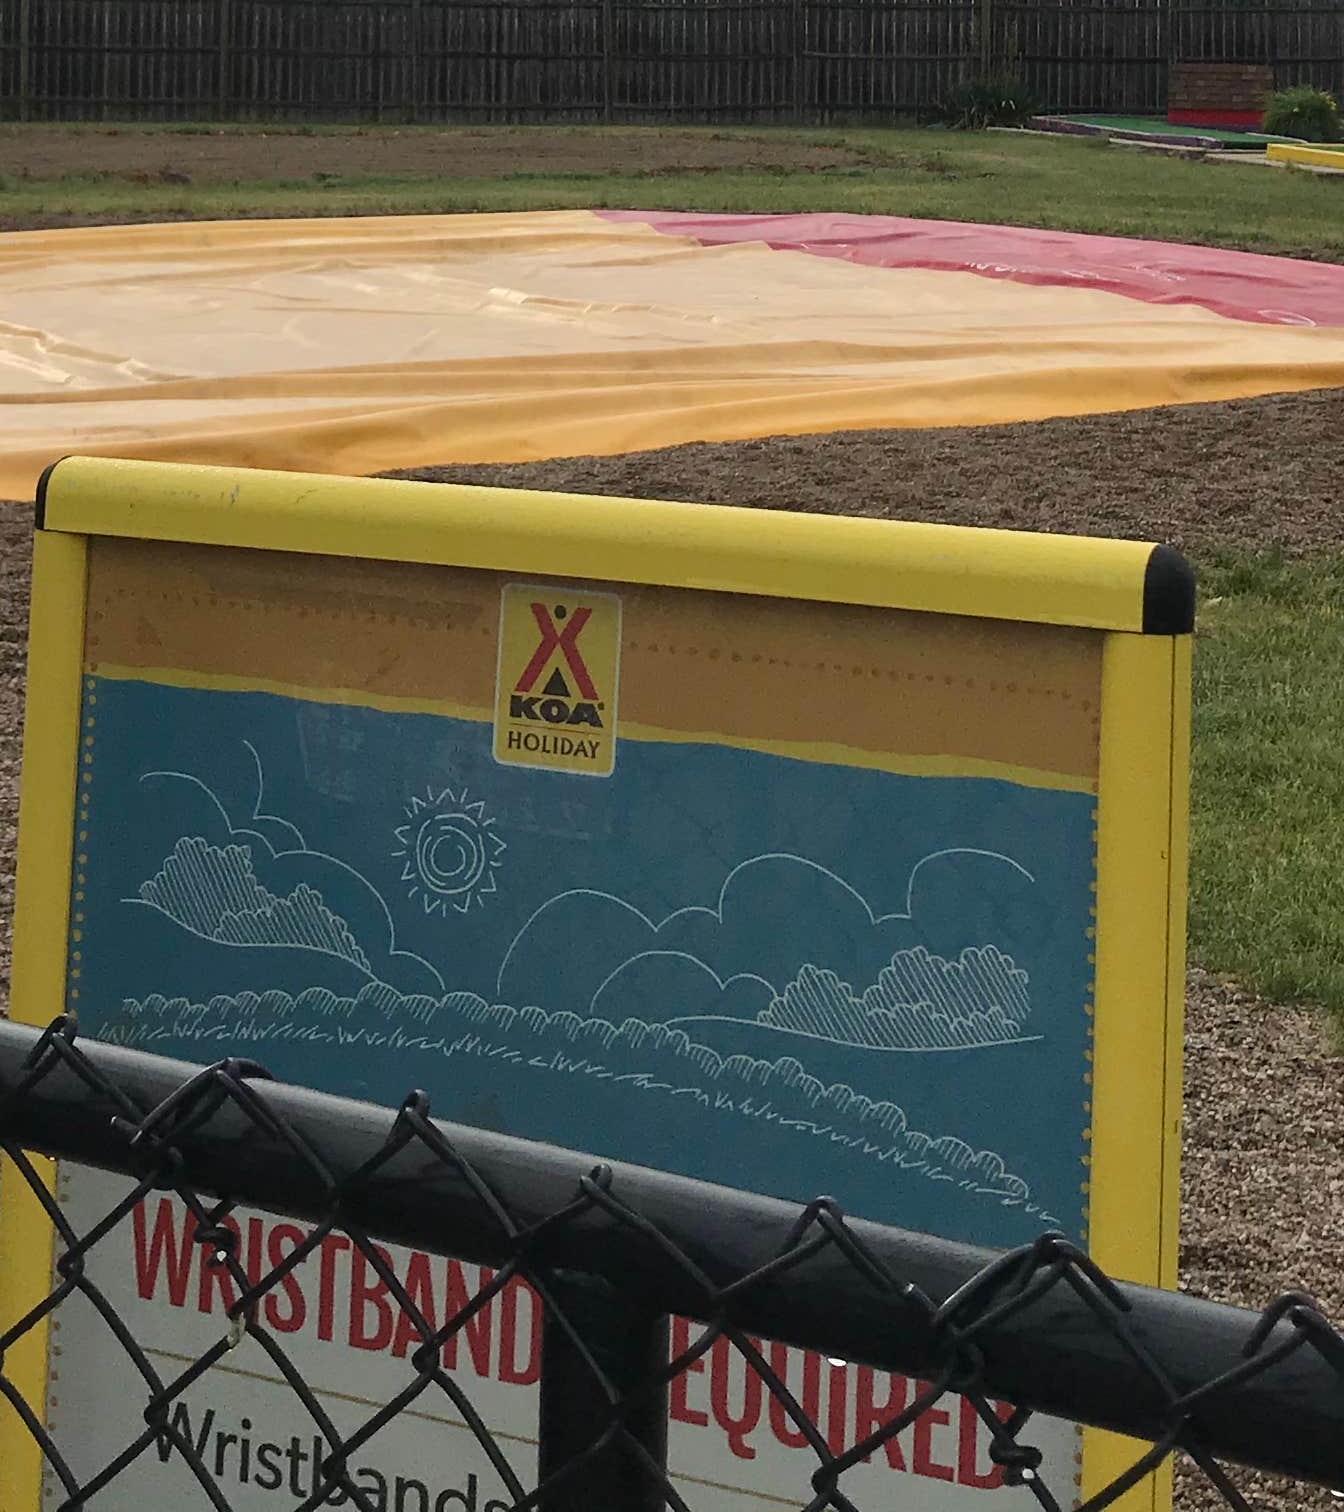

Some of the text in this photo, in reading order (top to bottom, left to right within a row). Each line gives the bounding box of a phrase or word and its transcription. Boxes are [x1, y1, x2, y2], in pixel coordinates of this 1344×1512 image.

[507, 731, 601, 759] HOLIDAY
[509, 695, 603, 728] KOA
[131, 1196, 1020, 1490] WRISTBAND EQUIRED
[148, 1394, 525, 1512] Wristband
